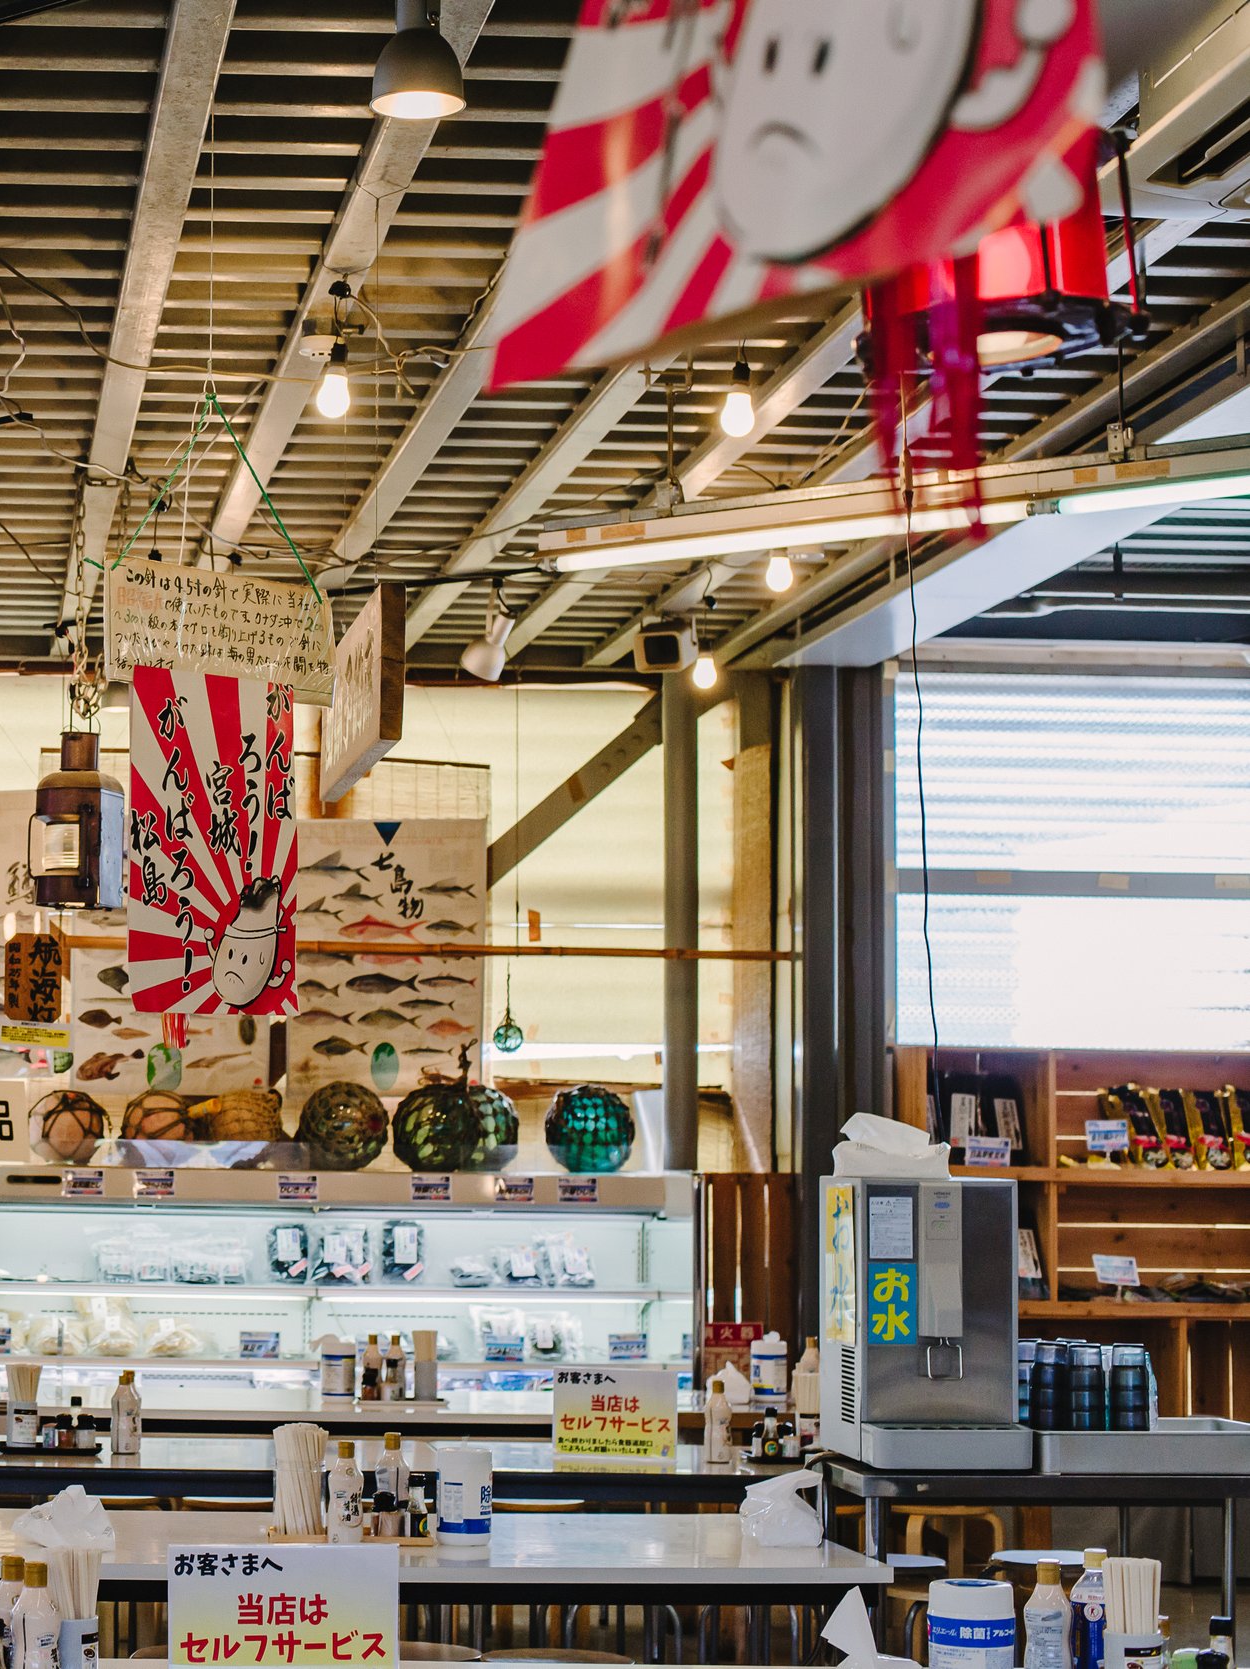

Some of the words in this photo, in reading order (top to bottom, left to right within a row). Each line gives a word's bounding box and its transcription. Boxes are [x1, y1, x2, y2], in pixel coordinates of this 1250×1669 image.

[205, 761, 243, 858] 宮城
[131, 809, 169, 907] 松島
[872, 1268, 911, 1341] お水
[557, 1371, 617, 1385] お客さまへ
[591, 1394, 640, 1413] 当店は
[560, 1413, 671, 1434] セルフサービス
[174, 1552, 284, 1577] お客さまへ
[237, 1593, 329, 1626] 当店は
[180, 1630, 387, 1663] セルフサービス
[959, 1626, 986, 1640] 除菌
